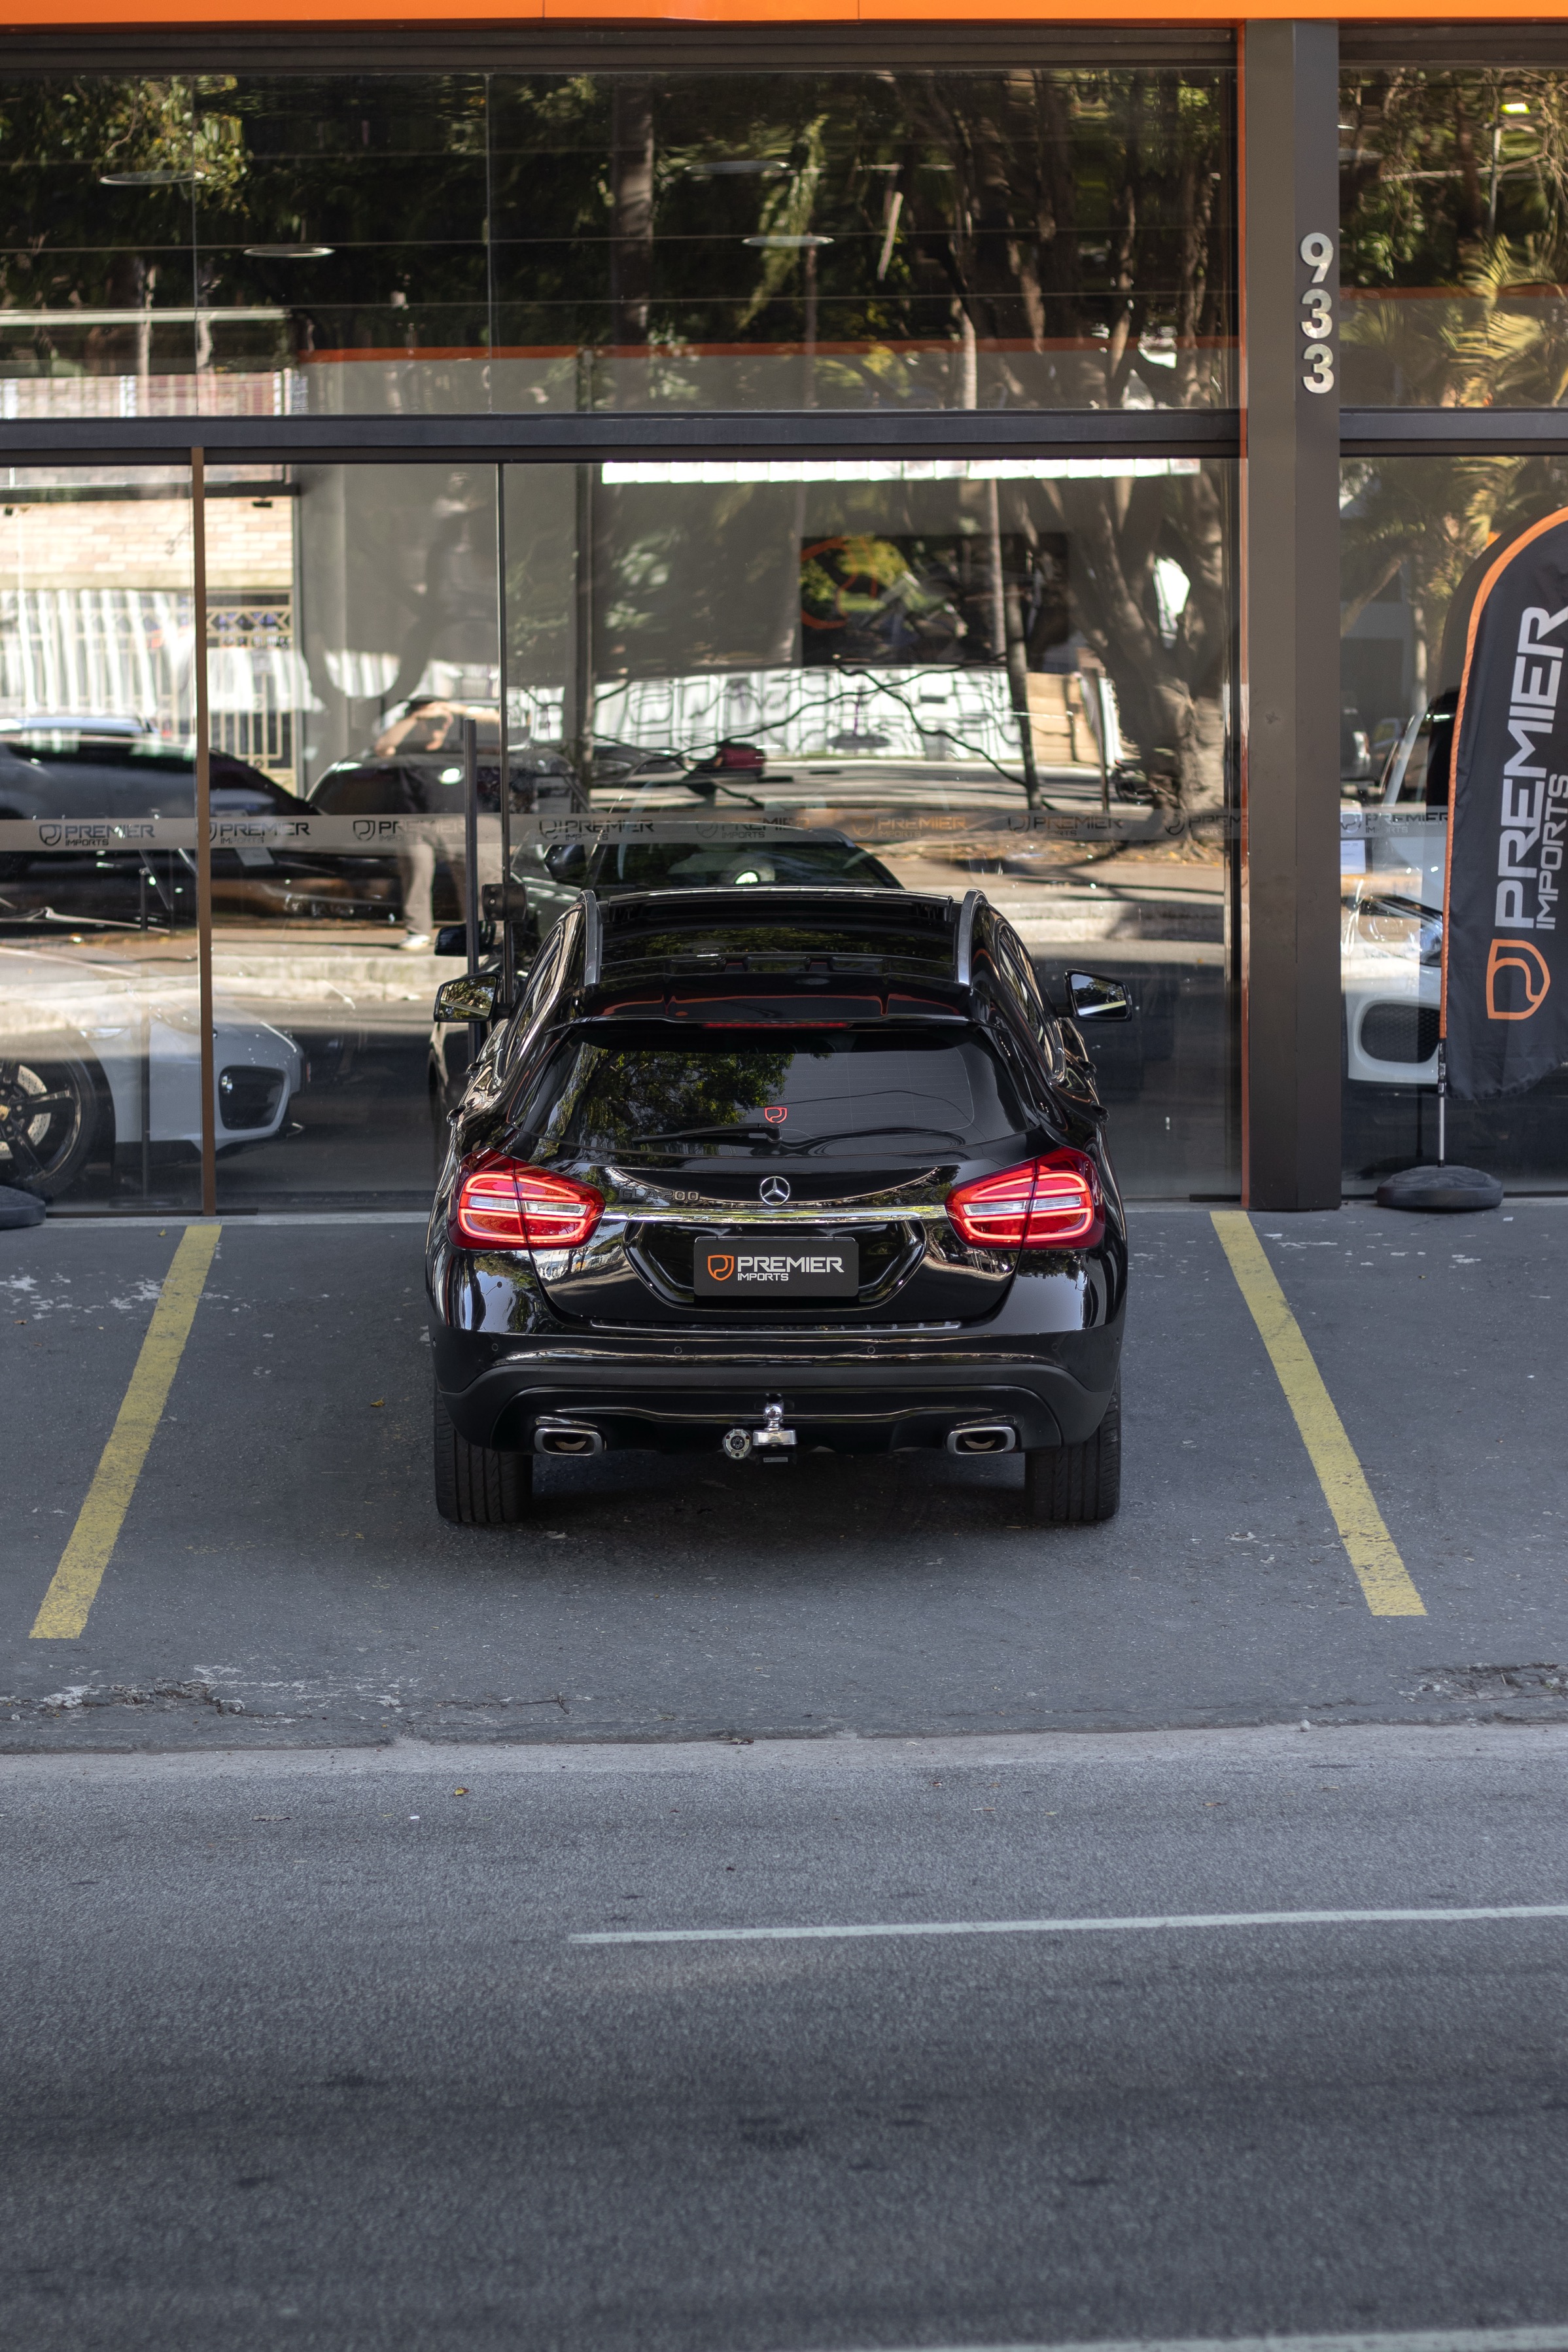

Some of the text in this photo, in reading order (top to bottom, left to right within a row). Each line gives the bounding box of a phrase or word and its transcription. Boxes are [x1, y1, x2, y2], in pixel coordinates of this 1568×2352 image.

[1300, 232, 1334, 394] 933
[1495, 606, 1568, 928] PREMIER
[878, 816, 968, 830] PREMIER
[1034, 816, 1123, 829] PREMIER
[65, 824, 155, 837] PREMIER
[1537, 773, 1568, 929] IMPORTS
[661, 1190, 700, 1201] 200
[737, 1256, 845, 1273] PREMIER
